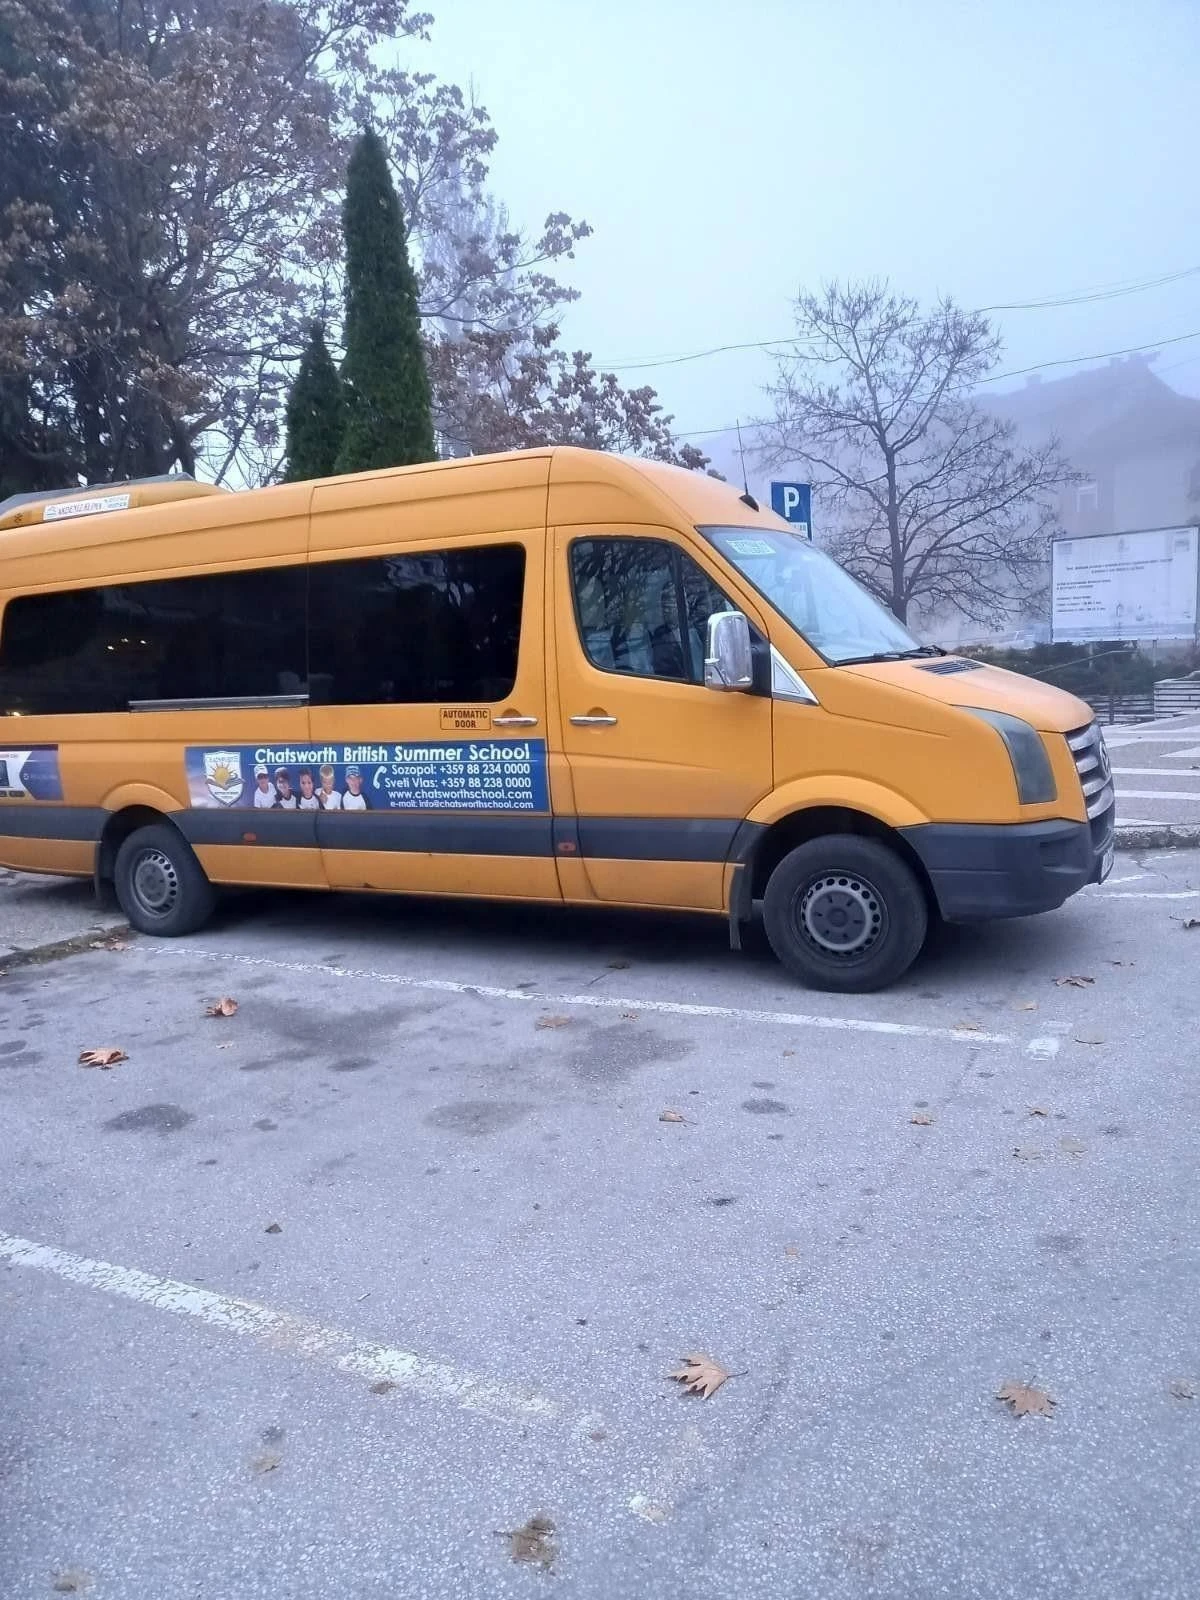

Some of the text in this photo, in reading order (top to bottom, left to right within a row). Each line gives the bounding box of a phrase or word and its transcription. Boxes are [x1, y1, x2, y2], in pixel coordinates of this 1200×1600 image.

[783, 486, 800, 518] P
[443, 710, 488, 719] AUTOMATIC
[455, 720, 476, 728] DOOR
[254, 743, 530, 763] Chatsworth British Summer School
[391, 763, 530, 776] Sozopol: +359 88 234 0000
[384, 777, 531, 788] Sveti Vlas: +359 88 238 0000
[388, 789, 533, 800] www.chatsworthschool.com
[419, 800, 534, 809] info@chatsworthschool.com
